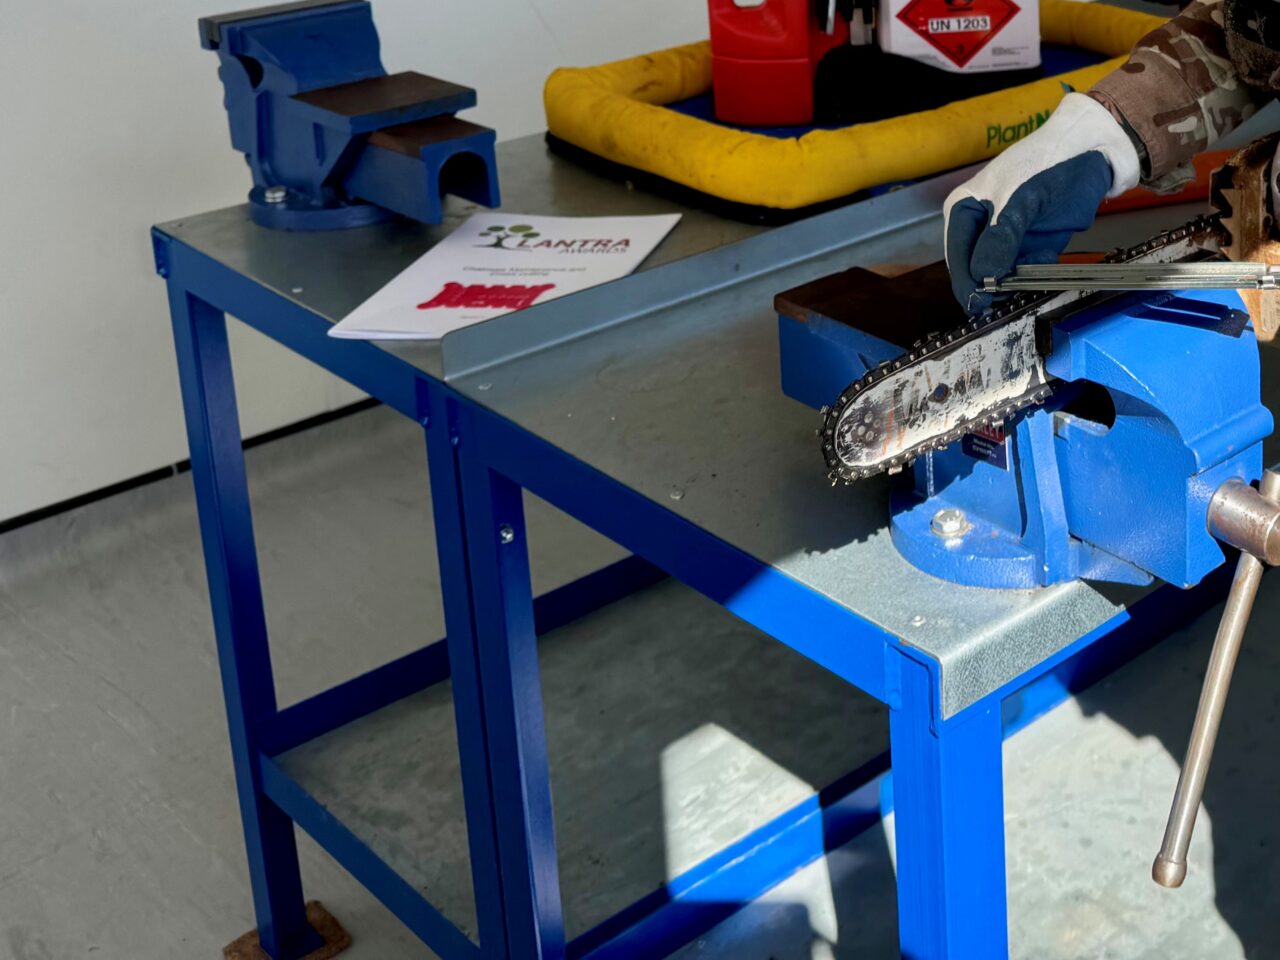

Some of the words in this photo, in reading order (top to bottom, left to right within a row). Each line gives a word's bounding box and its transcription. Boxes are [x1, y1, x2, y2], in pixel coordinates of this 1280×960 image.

[930, 20, 951, 32] UN
[957, 17, 989, 31] 1203
[986, 109, 1052, 149] PlantN
[517, 238, 631, 249] LANTRA
